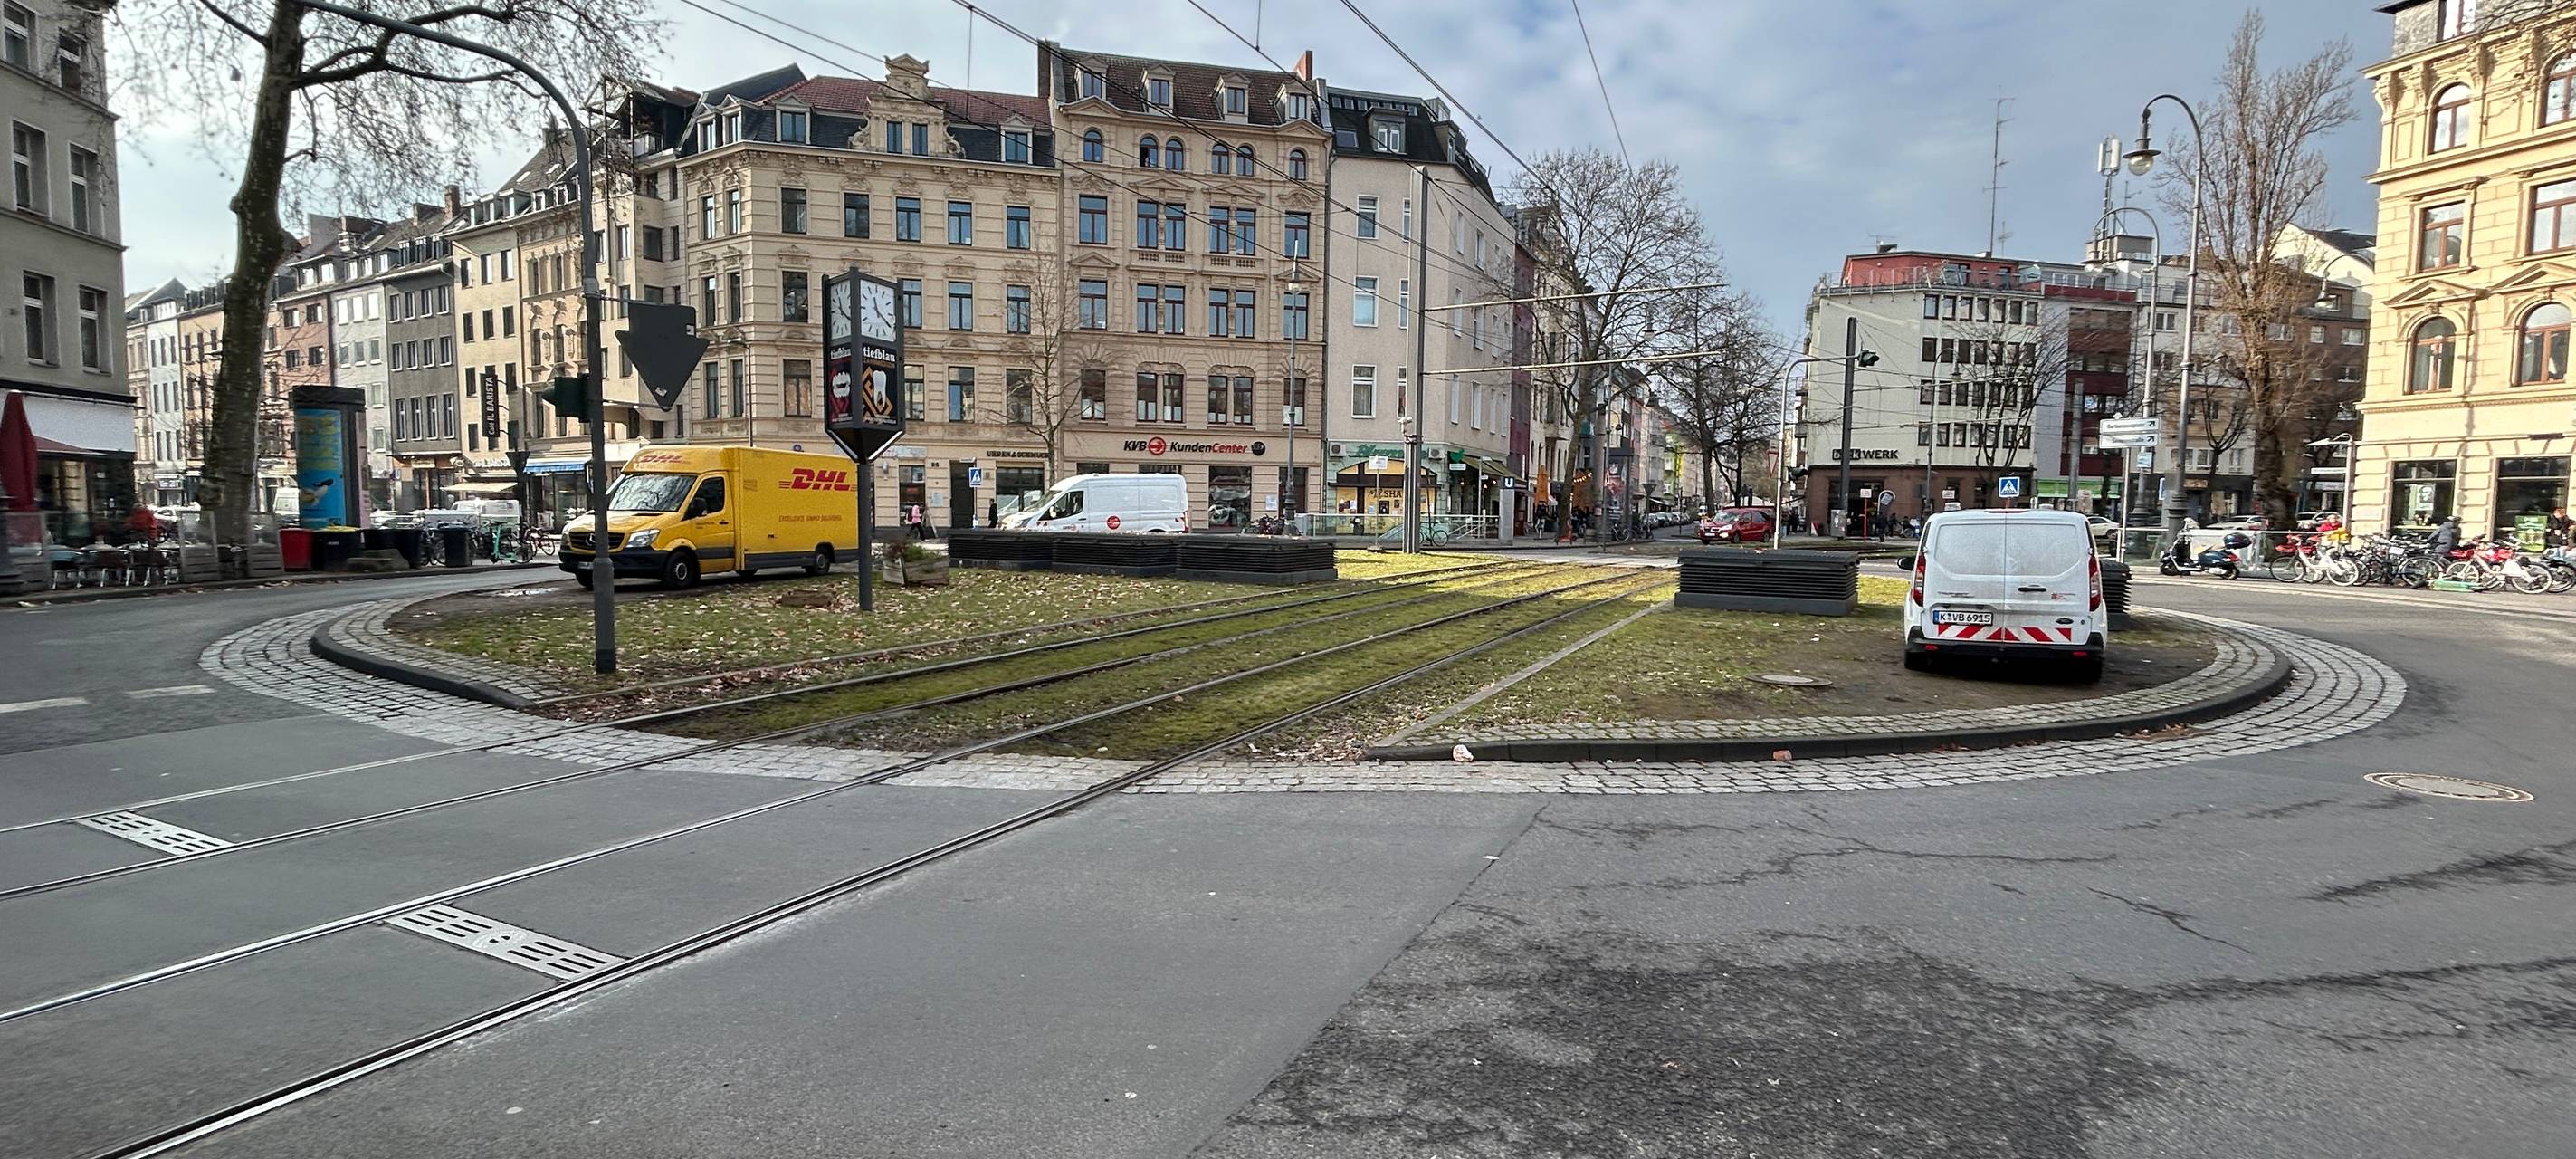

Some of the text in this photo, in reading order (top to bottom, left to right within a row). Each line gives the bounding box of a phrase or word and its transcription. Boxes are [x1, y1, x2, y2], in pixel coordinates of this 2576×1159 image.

[863, 346, 896, 362] tiefblau
[485, 377, 495, 412] BARISTA
[1123, 441, 1147, 452] KVB
[1169, 442, 1248, 454] KundenCenter
[640, 455, 682, 464] DHL
[1832, 449, 1899, 460] bkWERK
[791, 468, 851, 492] DHL
[1504, 477, 1513, 488] U
[1952, 613, 1965, 622] VB
[1966, 614, 1991, 623] 6915
